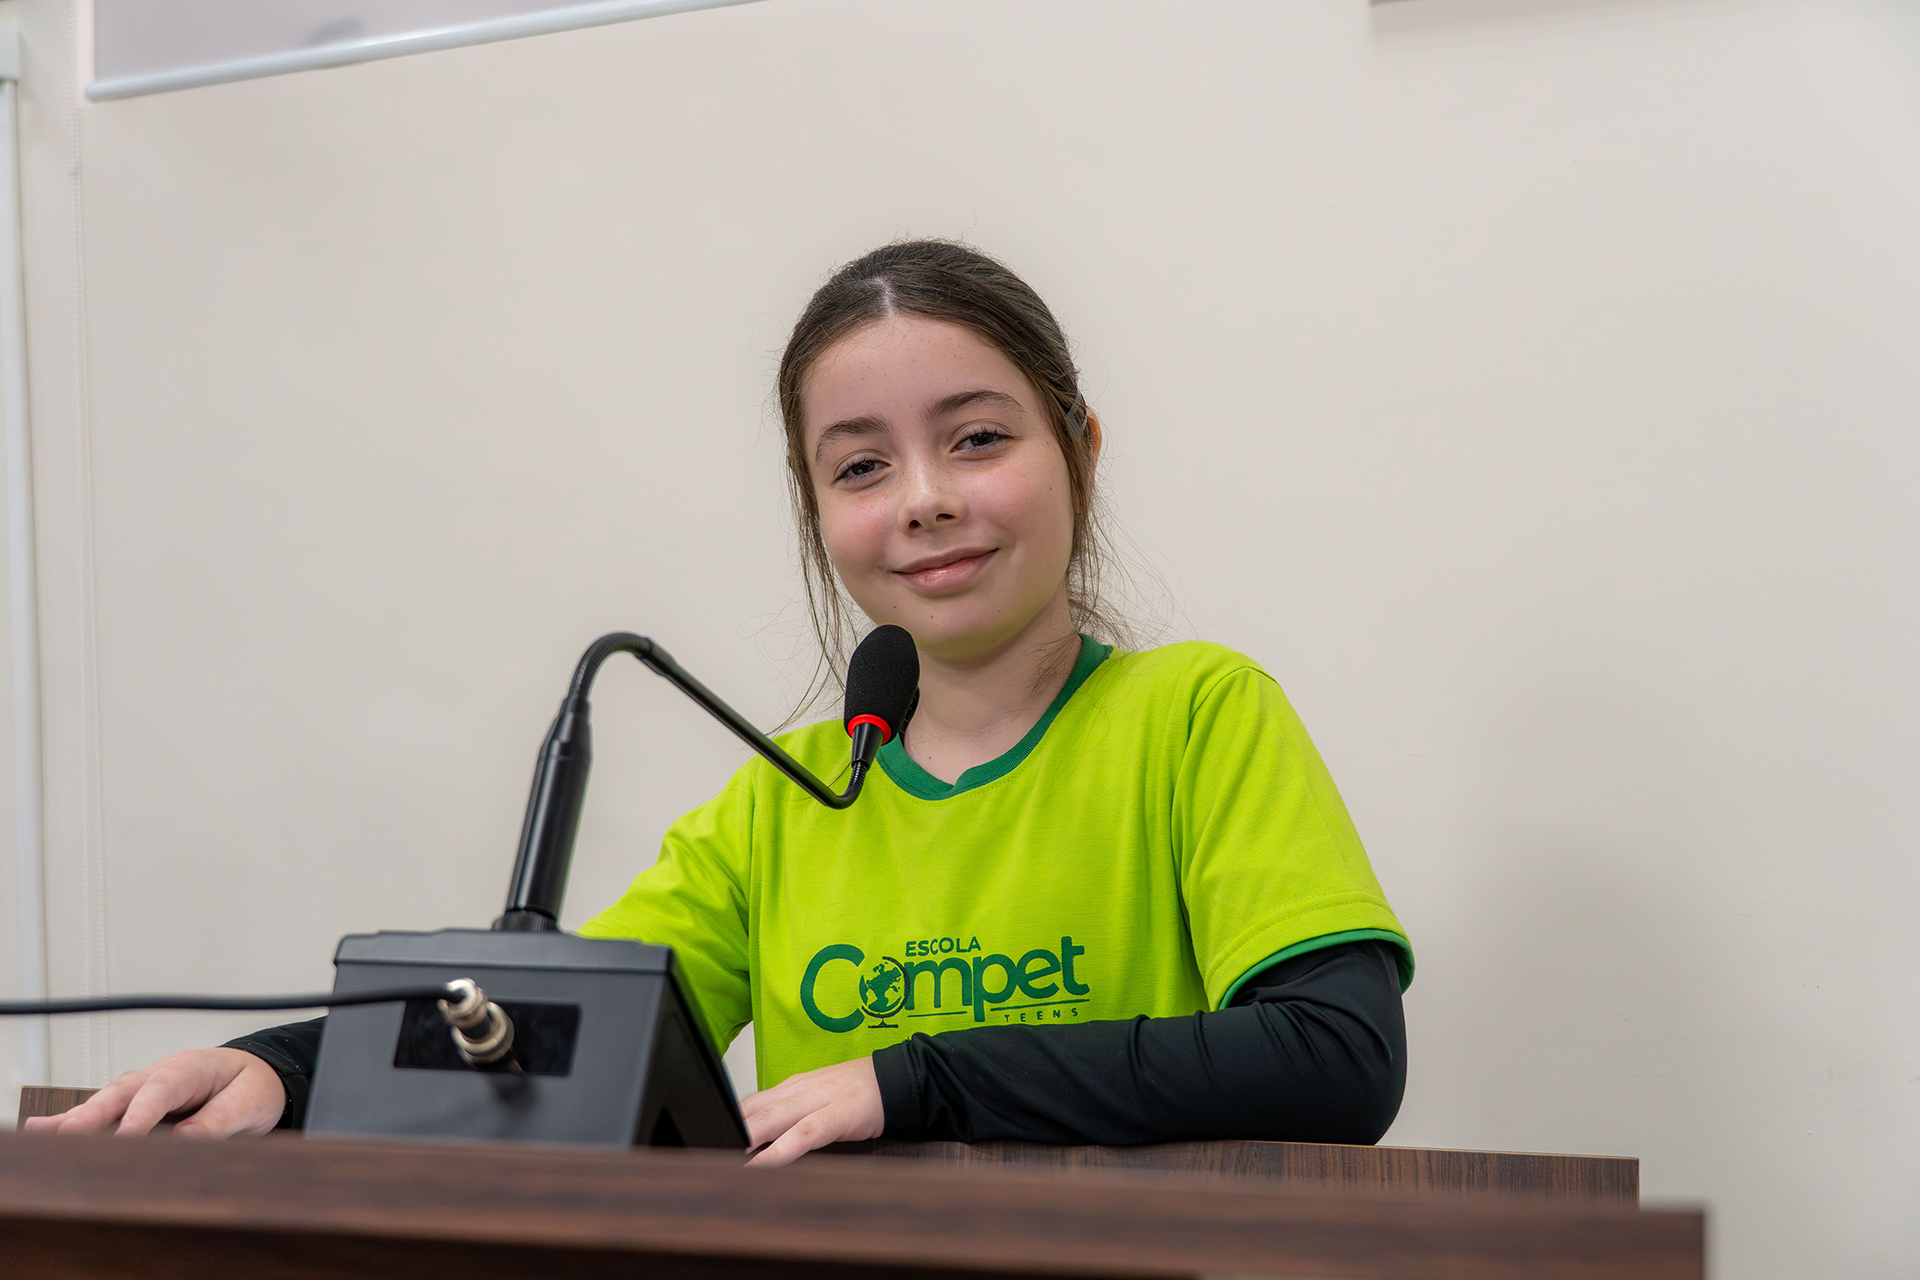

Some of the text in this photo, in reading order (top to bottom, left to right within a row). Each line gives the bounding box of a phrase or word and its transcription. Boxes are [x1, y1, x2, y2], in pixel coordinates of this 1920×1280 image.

[905, 936, 981, 957] ESCOLA
[800, 936, 1090, 1033] Compet
[1004, 1007, 1078, 1023] TEENS
